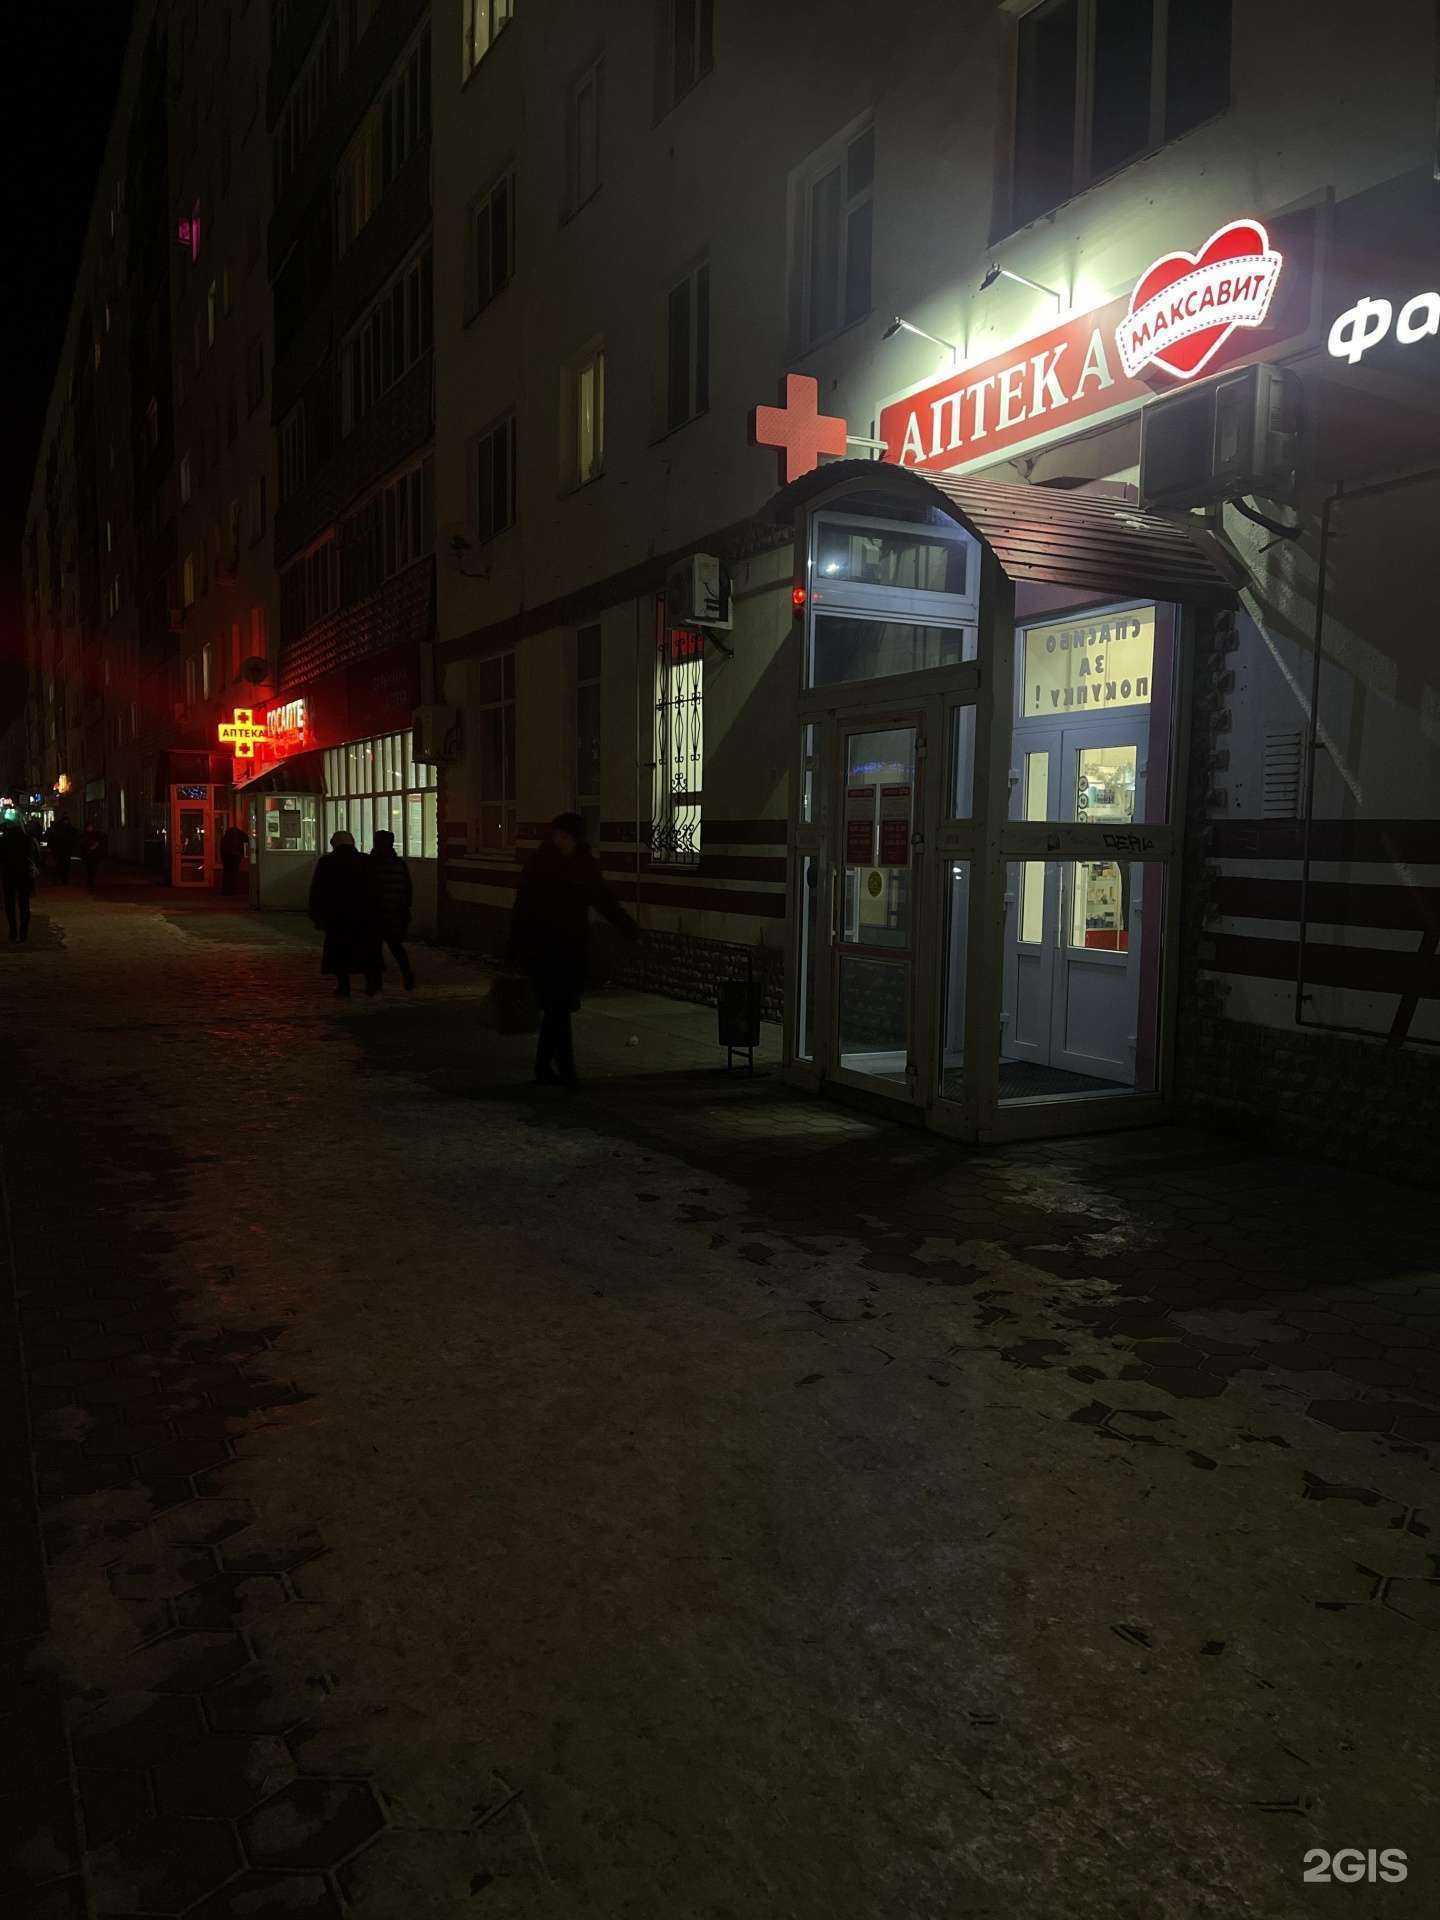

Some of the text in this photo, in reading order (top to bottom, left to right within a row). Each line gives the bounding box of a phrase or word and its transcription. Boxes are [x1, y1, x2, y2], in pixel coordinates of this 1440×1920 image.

[1130, 273, 1266, 354] МАКСАВИТ
[899, 328, 1115, 465] АПТЕКА
[222, 728, 265, 738] АПТЕКА
